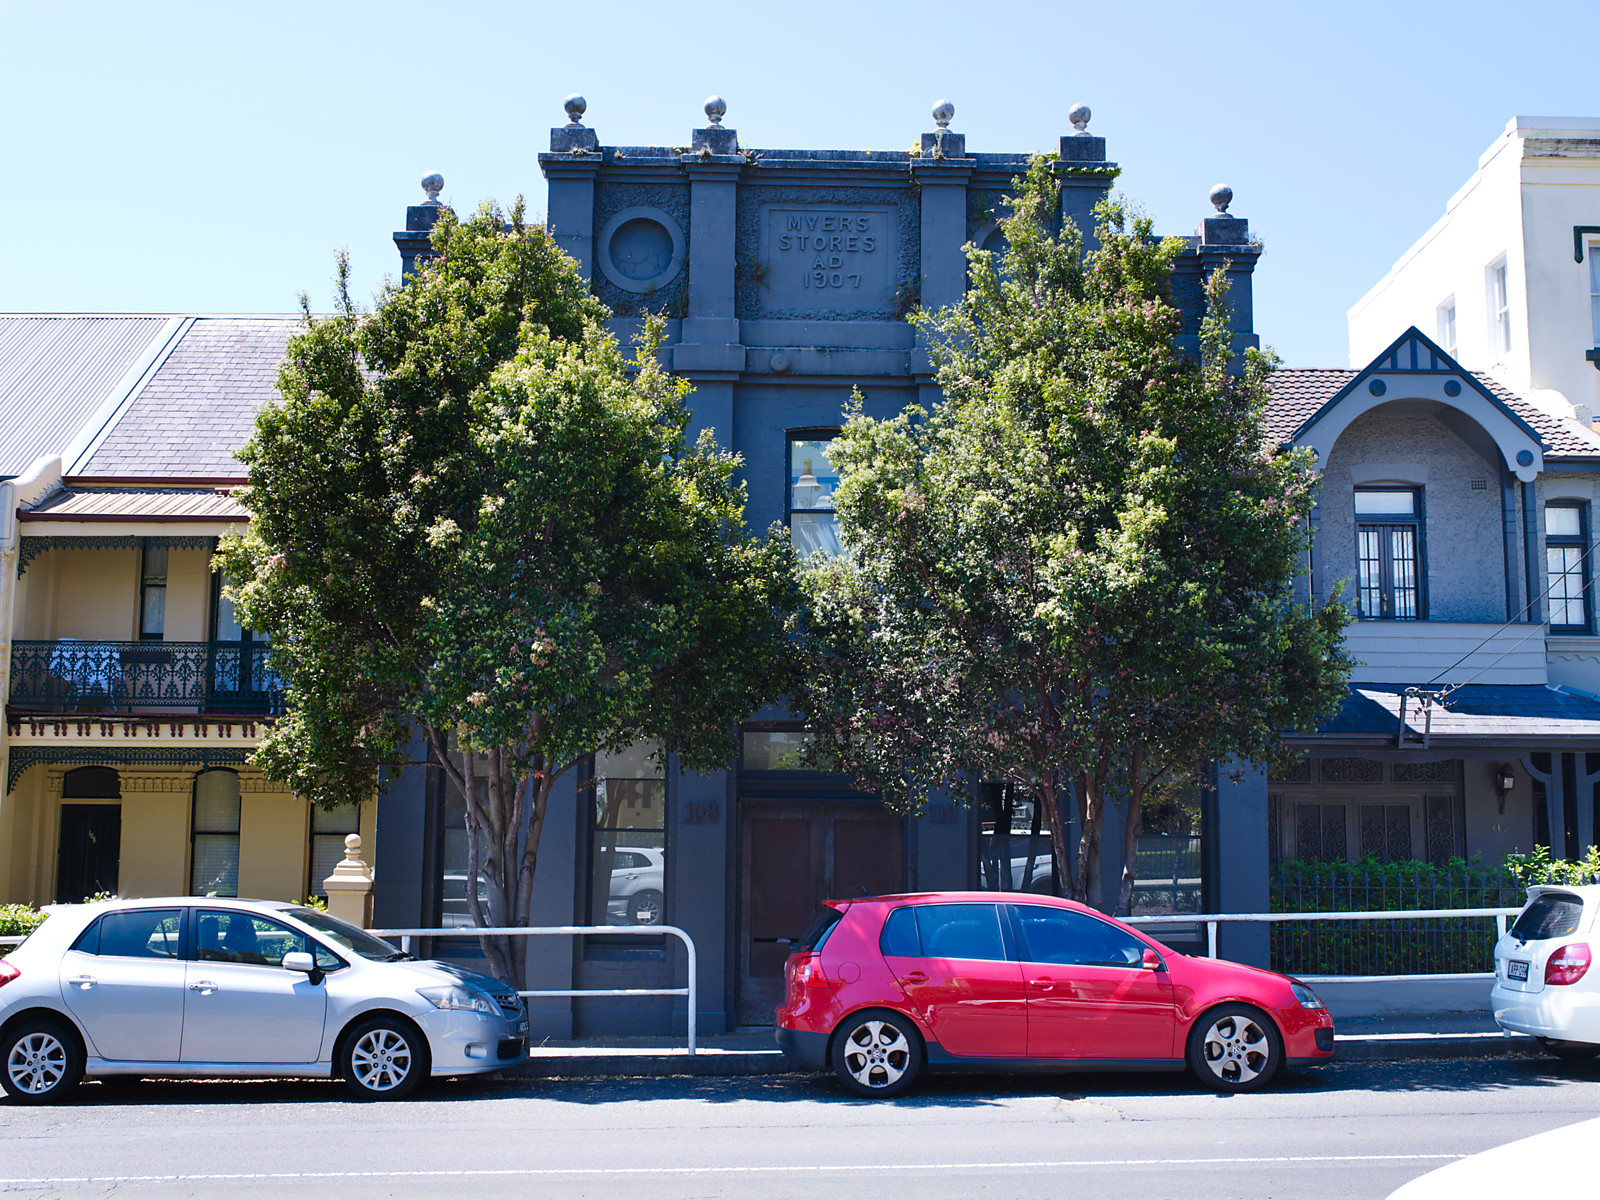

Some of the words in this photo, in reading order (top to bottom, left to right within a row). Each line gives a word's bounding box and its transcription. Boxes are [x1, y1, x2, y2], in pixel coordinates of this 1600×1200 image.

[787, 215, 870, 232] MYERS
[779, 234, 876, 253] STORES
[812, 255, 844, 270] AD
[804, 272, 862, 289] 1907
[685, 802, 719, 821] 108
